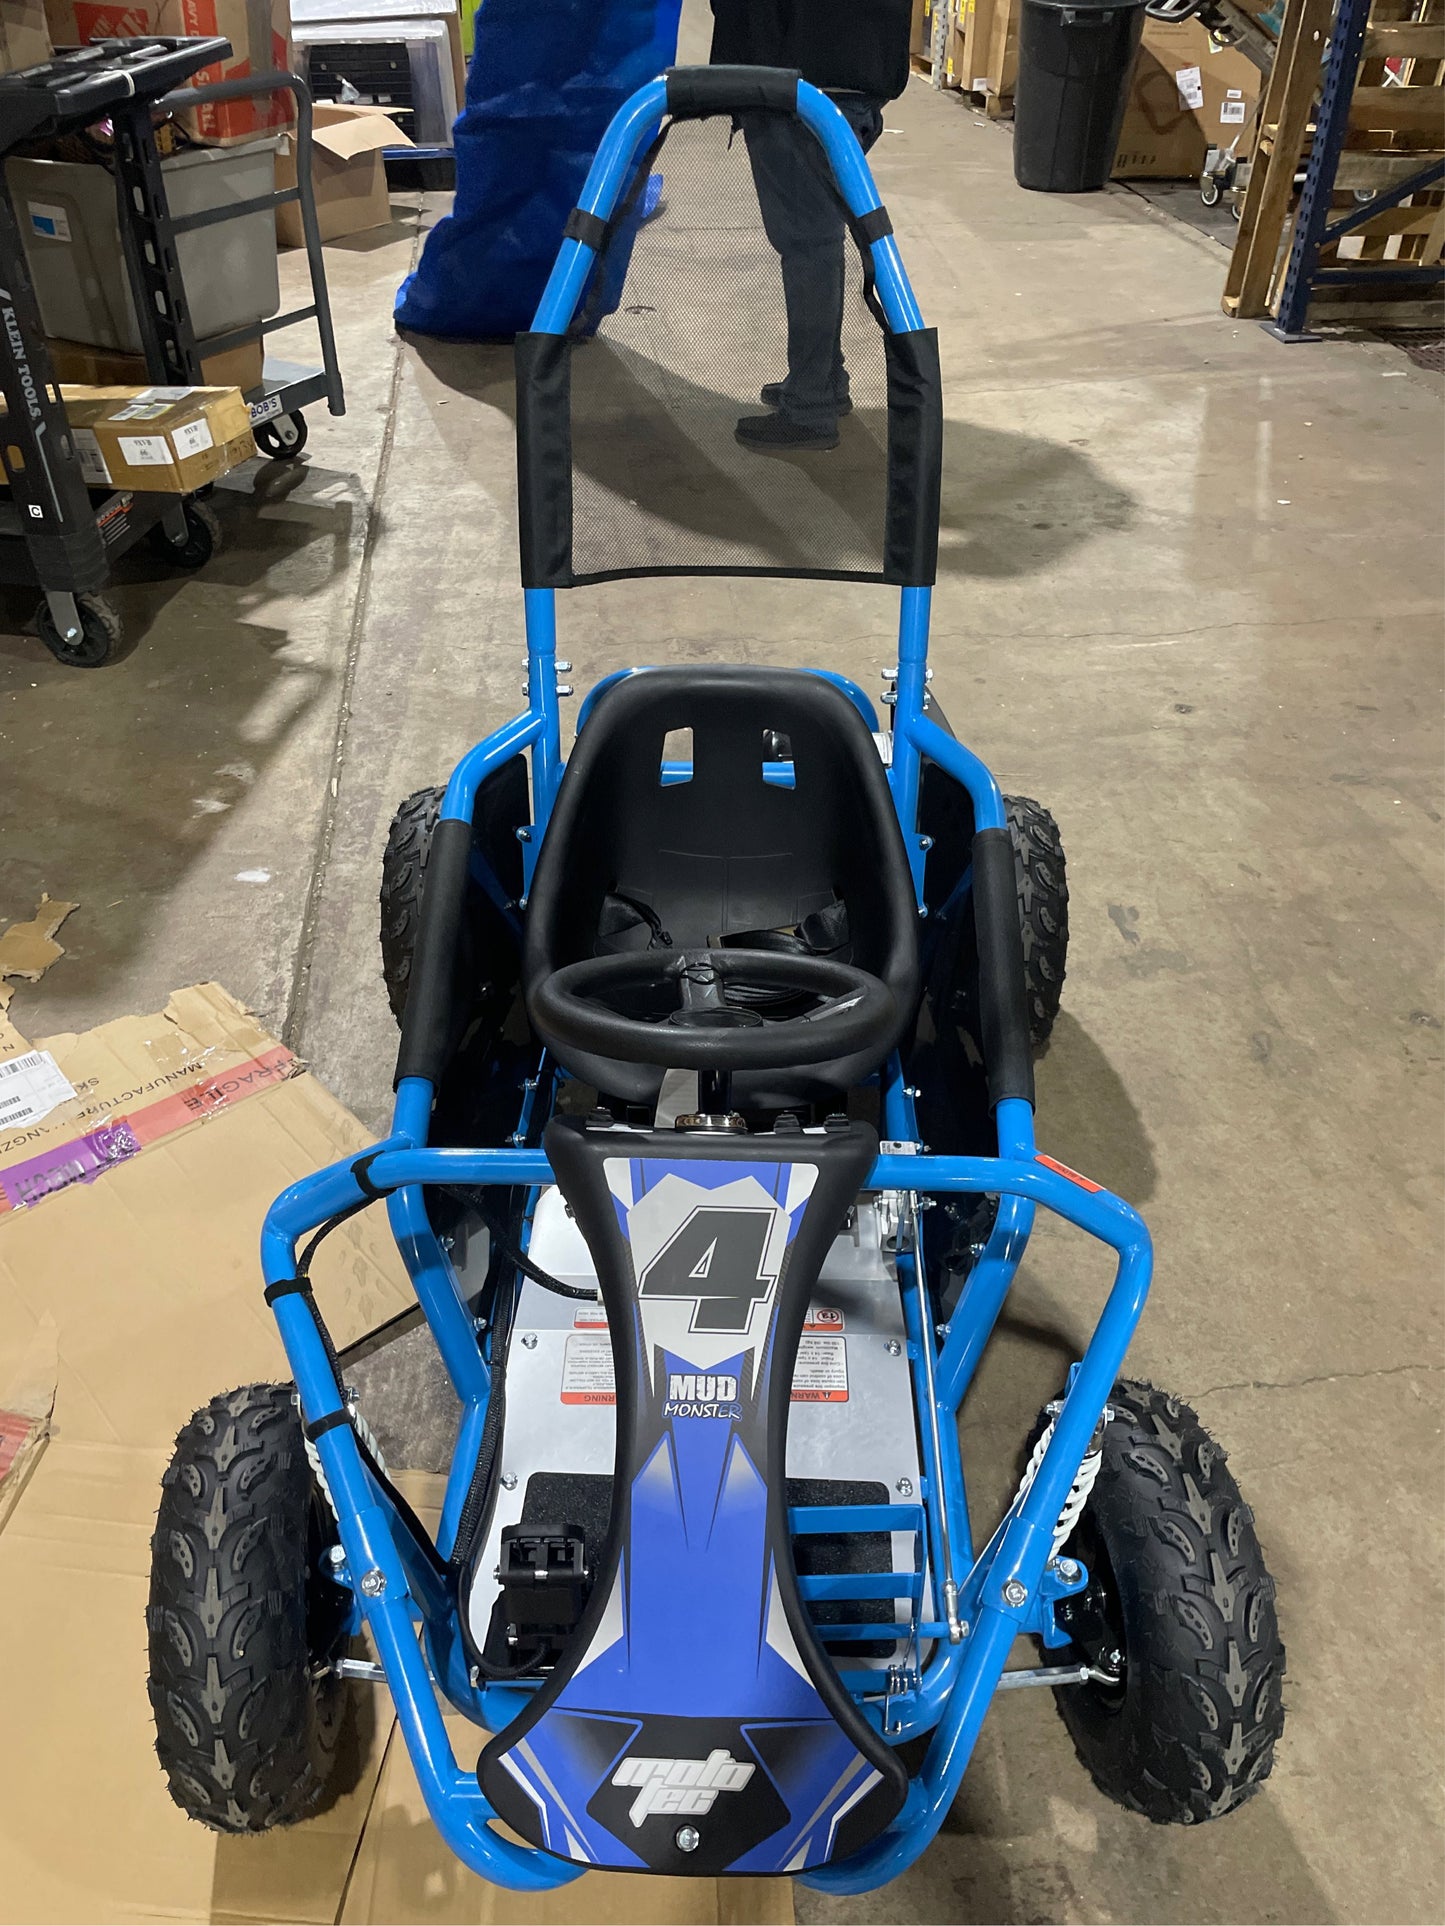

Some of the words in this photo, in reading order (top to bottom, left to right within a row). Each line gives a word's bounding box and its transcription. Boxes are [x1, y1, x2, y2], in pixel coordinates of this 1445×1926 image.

[2, 306, 27, 360] KLEIN
[18, 363, 42, 419] TOOLS
[251, 399, 278, 418] BOB'S
[183, 1058, 287, 1111] FRAGILE
[638, 1205, 778, 1335] 4
[669, 1374, 738, 1402] MUD
[663, 1401, 743, 1421] MONSTER
